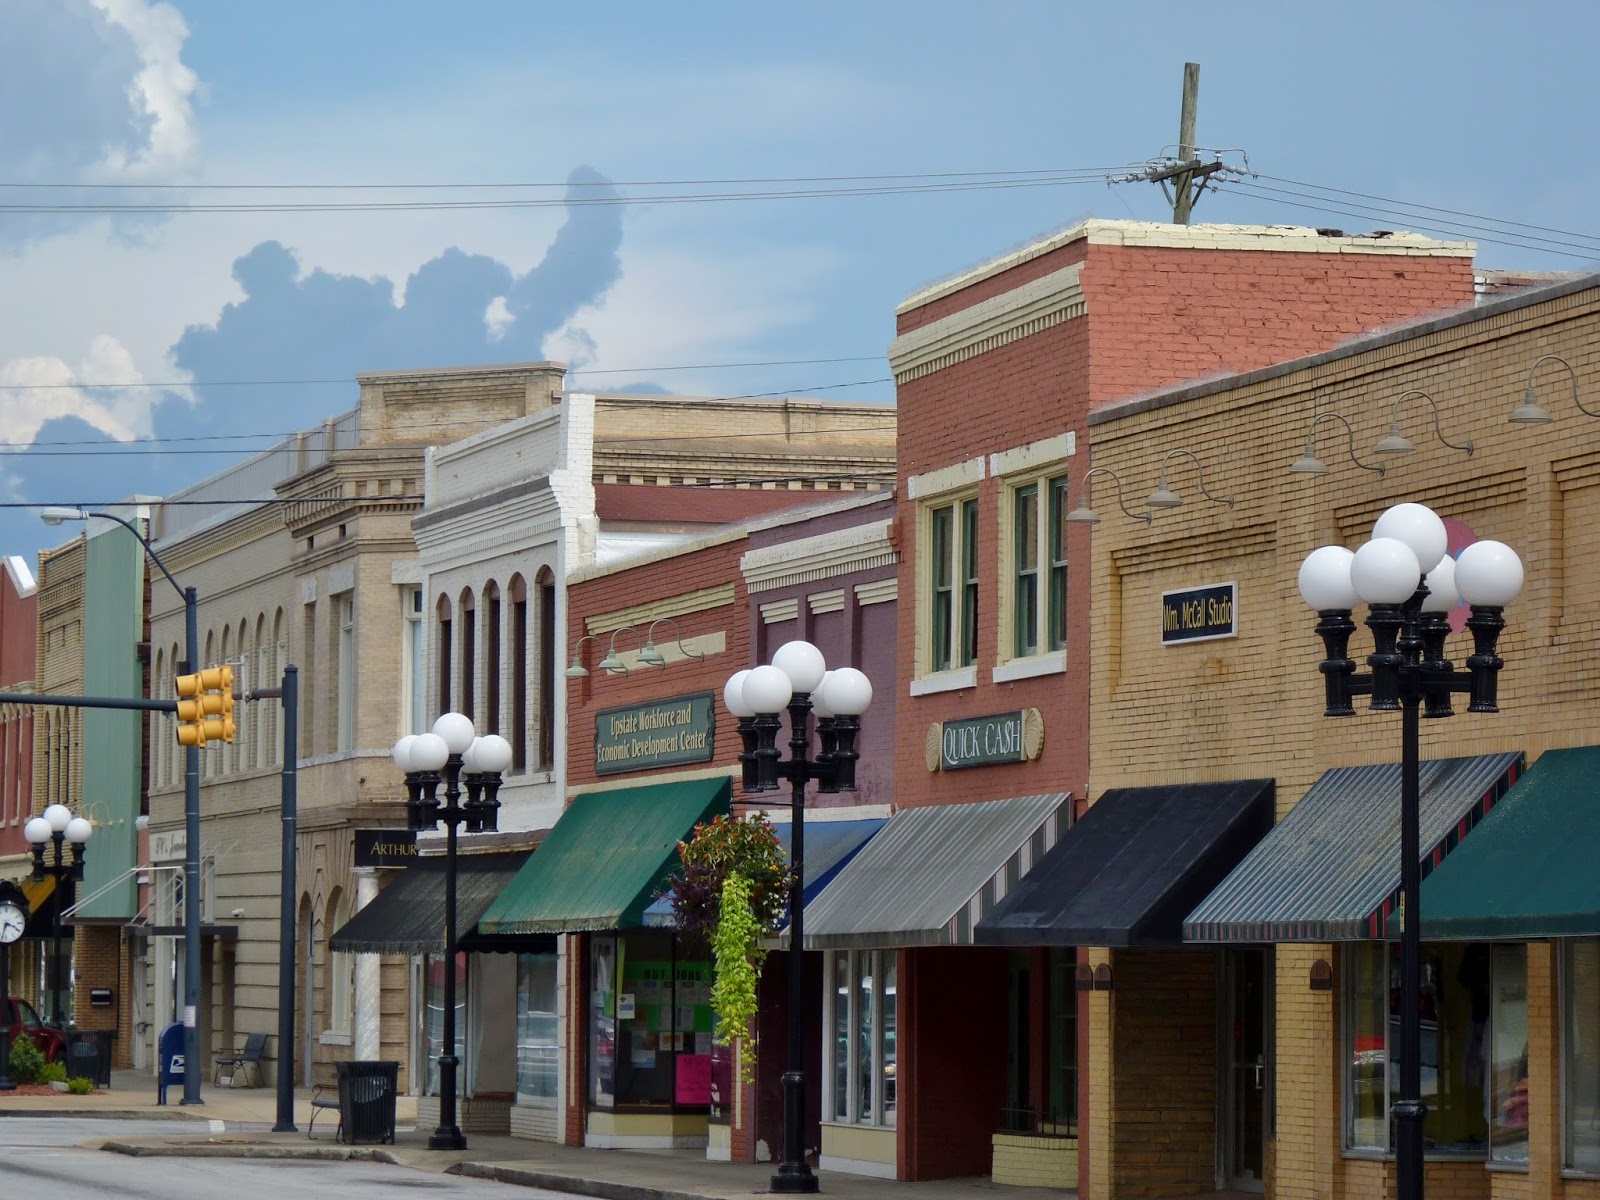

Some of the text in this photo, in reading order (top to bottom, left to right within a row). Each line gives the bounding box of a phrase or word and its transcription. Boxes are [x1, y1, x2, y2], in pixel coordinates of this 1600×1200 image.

[1164, 595, 1232, 631] Wm. McCall Studio
[611, 703, 692, 740] Upstate Workforce and
[597, 729, 707, 762] Economic Development Center
[944, 727, 980, 765] QUICK
[370, 841, 417, 855] ARTHUR
[644, 968, 702, 981] HOT JOBS
